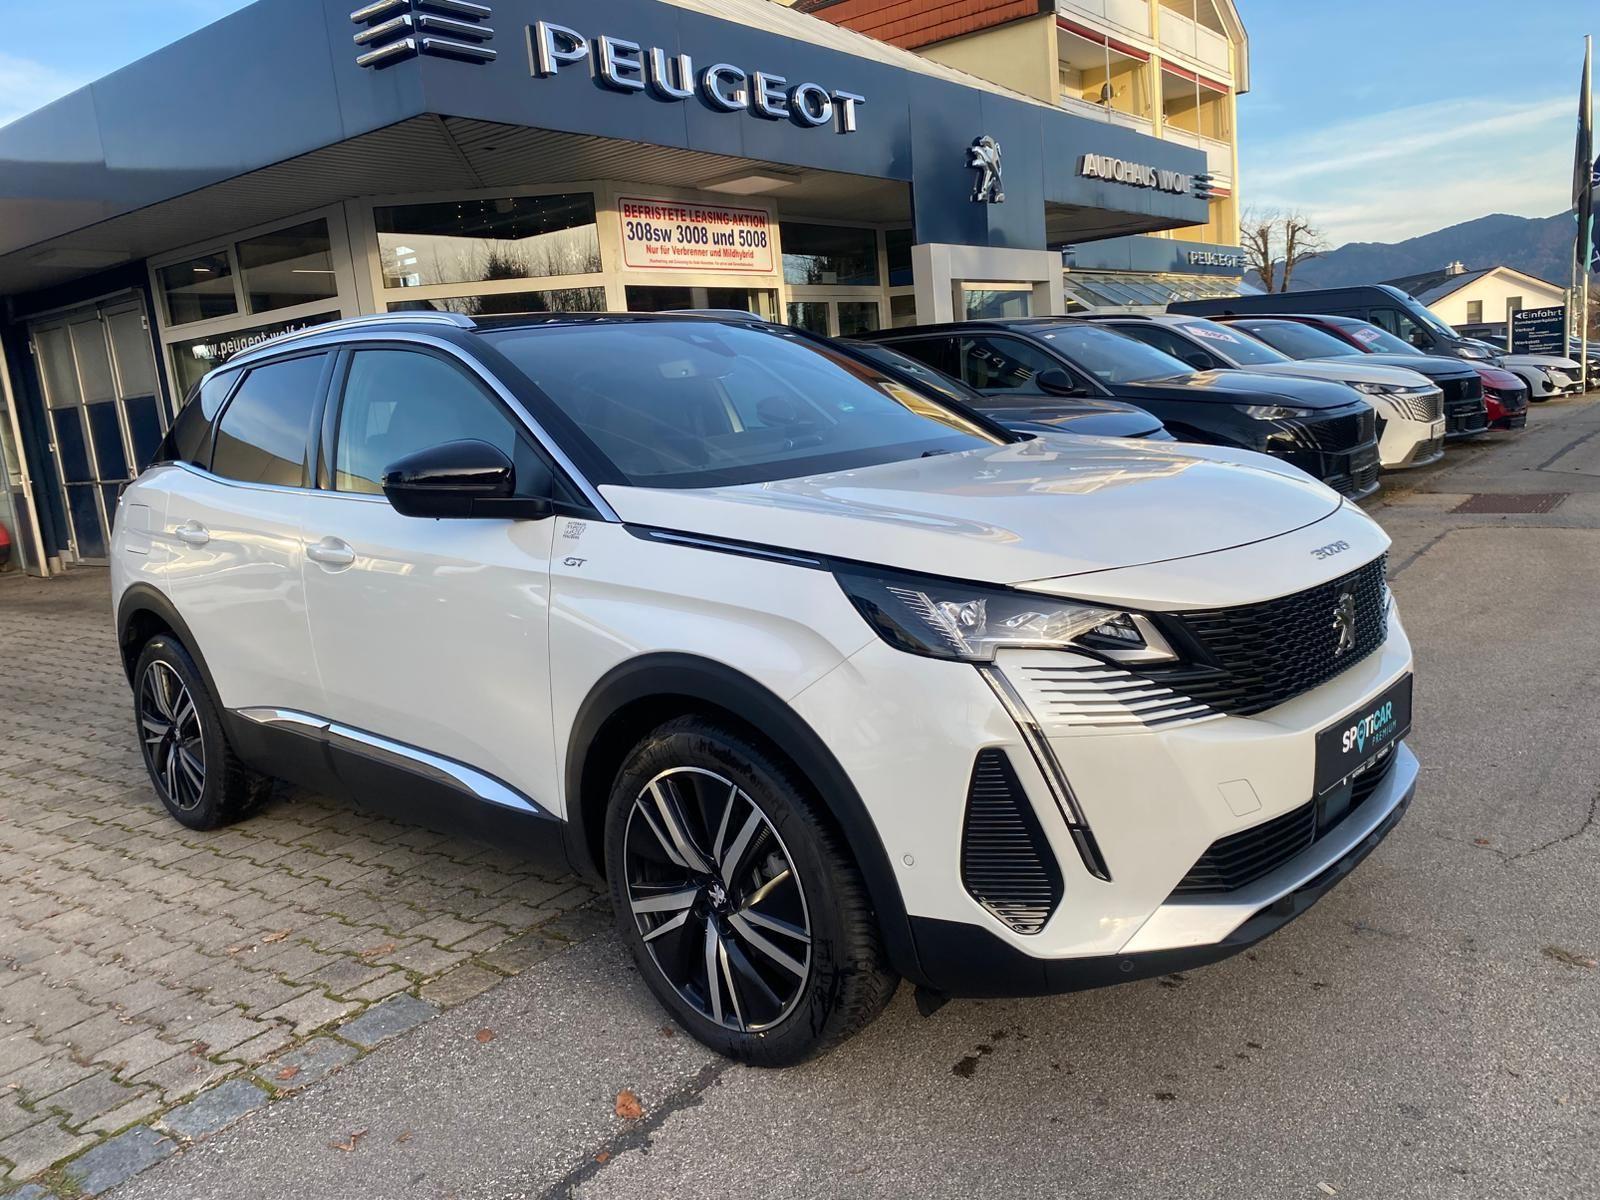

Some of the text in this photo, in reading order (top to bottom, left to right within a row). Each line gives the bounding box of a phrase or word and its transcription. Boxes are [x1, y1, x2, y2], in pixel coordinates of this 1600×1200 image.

[529, 20, 866, 133] PEUGEOT
[1082, 153, 1157, 187] AUTOHAUS
[623, 203, 766, 228] BEFRISTETE LEASING-AKTION
[626, 221, 767, 248] 308sw 3008 und 5008
[645, 244, 754, 261] Nur für Verbrenner und Mildhybrid
[1189, 251, 1238, 268] PEUGEOT
[1522, 310, 1563, 319] Einfahrt
[1310, 540, 1350, 560] 3008
[563, 557, 588, 567] GT
[1372, 719, 1397, 747] PREMIUM
